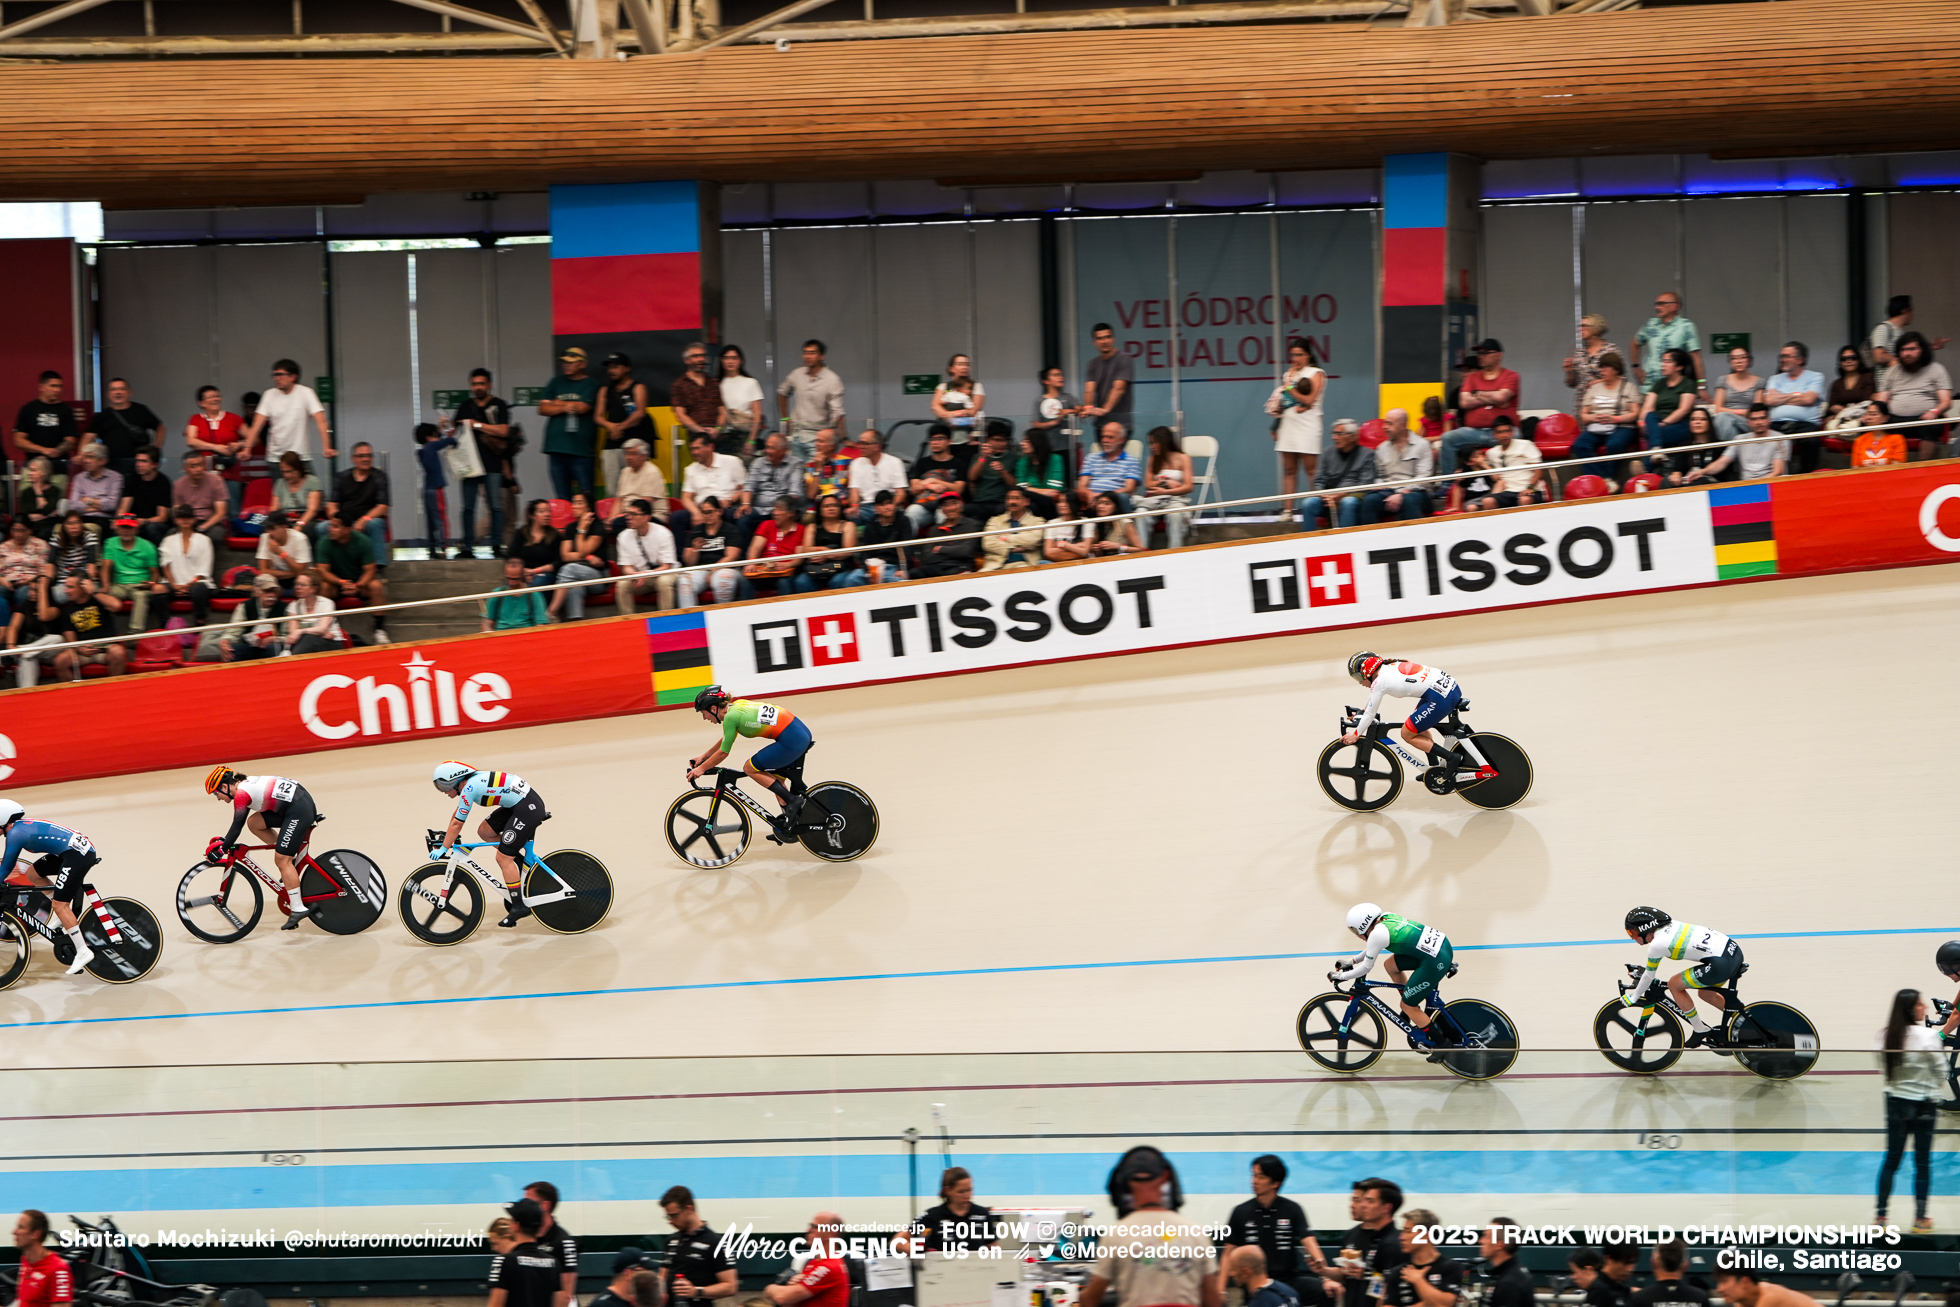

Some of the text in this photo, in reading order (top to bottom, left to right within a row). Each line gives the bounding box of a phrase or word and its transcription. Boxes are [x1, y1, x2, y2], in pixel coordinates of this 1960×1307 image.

[1114, 292, 1338, 329] VELÓDROMO
[1370, 517, 1667, 600] TISSOT
[870, 575, 1165, 658] TISSOT
[300, 652, 512, 739] Chile
[761, 705, 775, 719] 29
[1414, 702, 1437, 724] JAPAN
[278, 782, 292, 794] 42
[449, 768, 469, 779] LAZER
[725, 783, 773, 819] LOOK
[75, 835, 88, 847] 43
[281, 819, 299, 848] SLOVAKIA
[55, 866, 71, 890] USA
[242, 857, 282, 892] PARDUS
[329, 856, 369, 904] CORIMA
[467, 860, 508, 890] RIDLEY
[1358, 914, 1373, 932] KASK
[1638, 919, 1659, 932] KASK
[1701, 933, 1711, 944] 2
[1365, 995, 1412, 1034] PINARELLO
